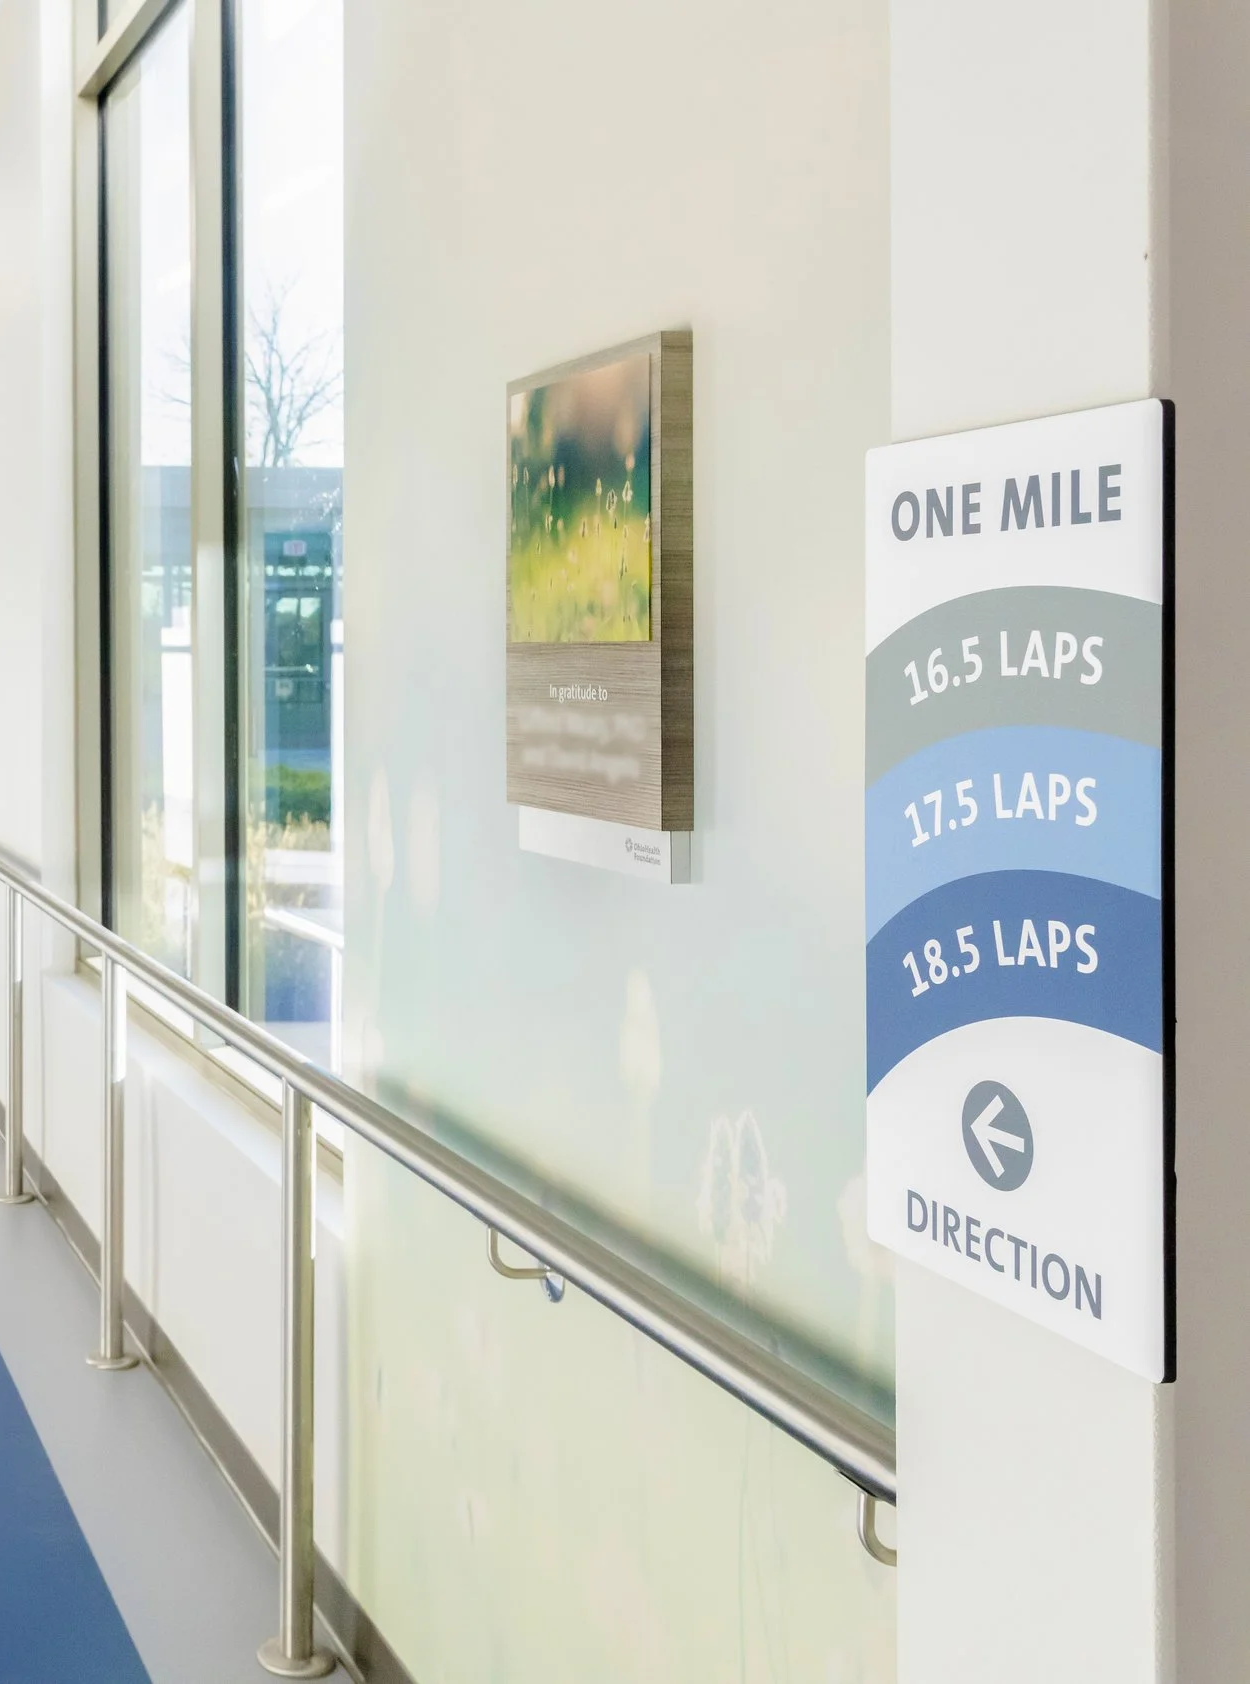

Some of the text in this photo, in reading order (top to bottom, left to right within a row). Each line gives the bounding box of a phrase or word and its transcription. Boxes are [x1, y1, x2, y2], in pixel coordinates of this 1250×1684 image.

[891, 463, 1121, 541] ONE MILE
[550, 683, 608, 703] In gratitude to
[903, 629, 1104, 706] 16.5 LAPS
[904, 772, 1098, 848] 17.5 LAPS
[902, 919, 1099, 998] 18.5 LAPS
[907, 1189, 1102, 1321] DIRECTION
